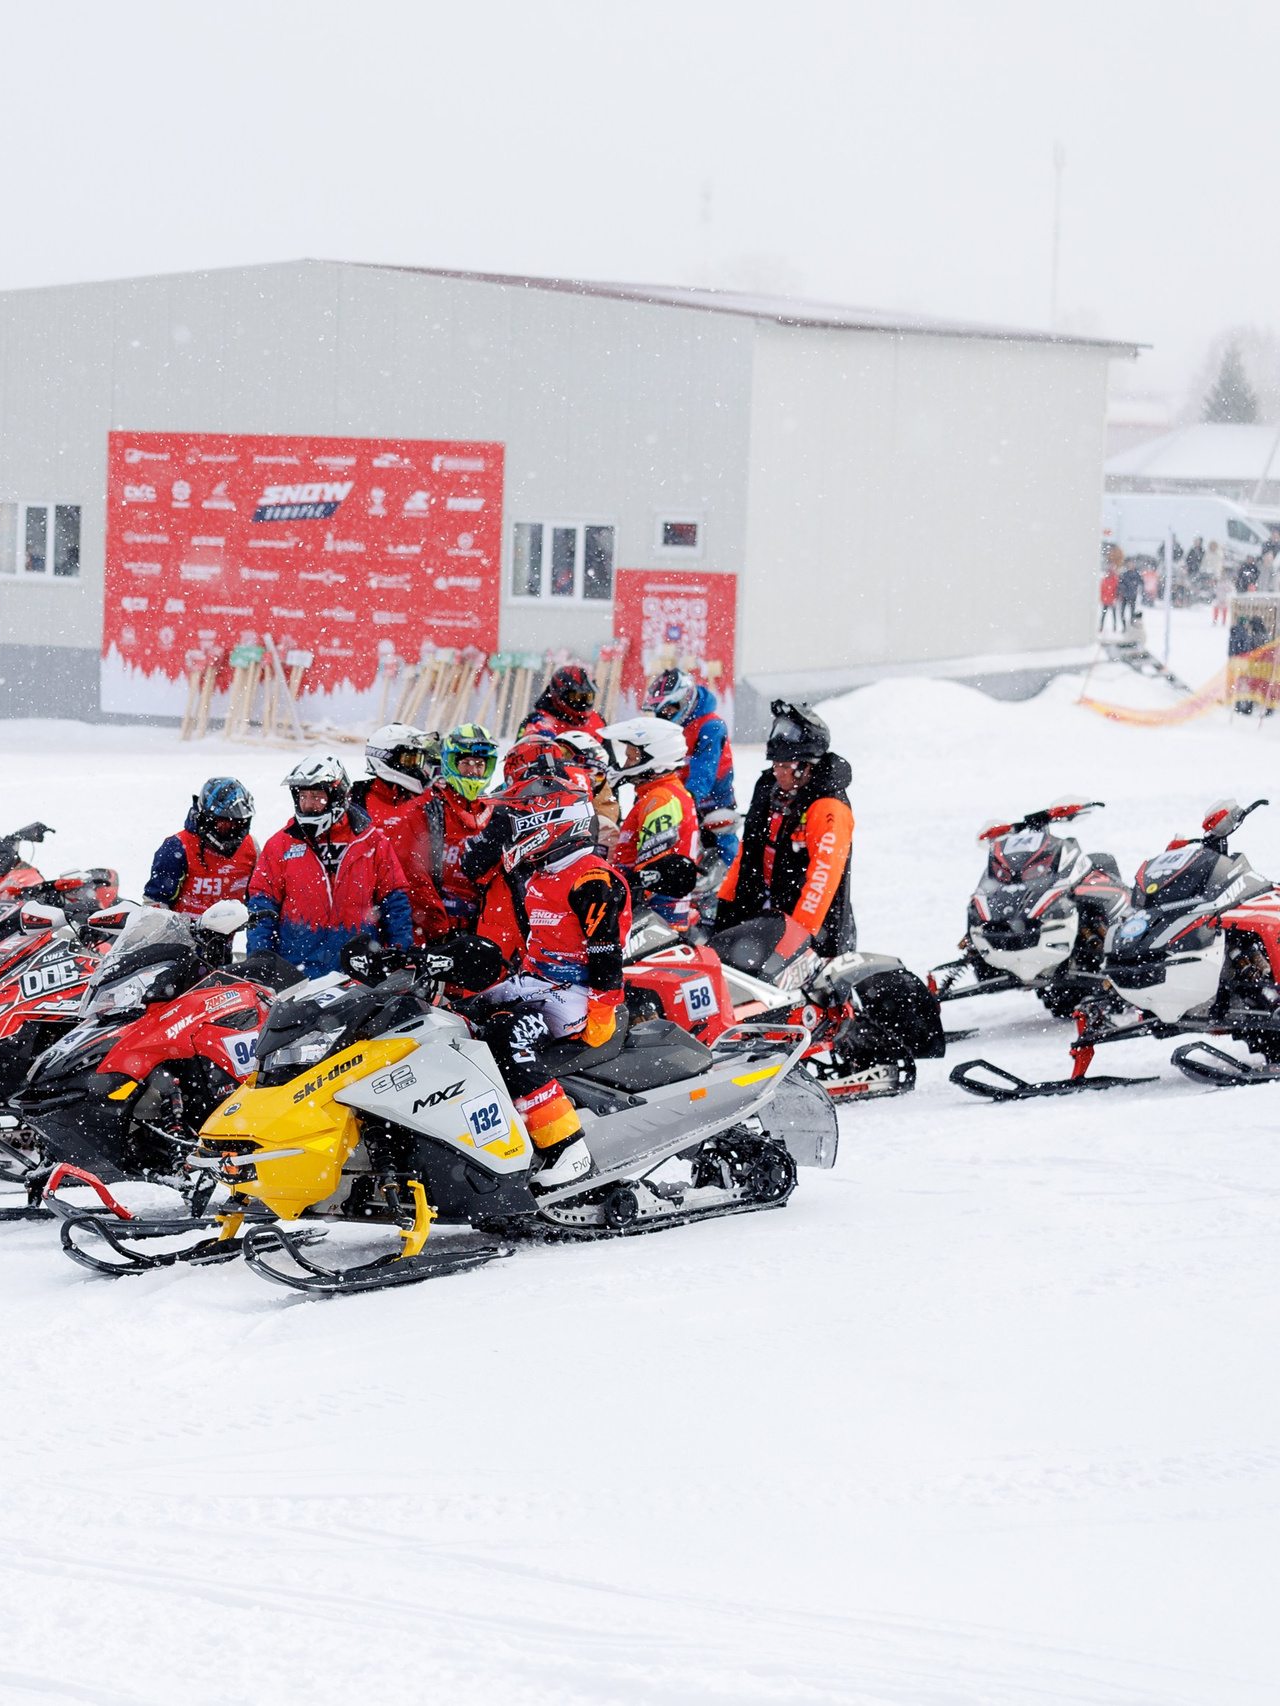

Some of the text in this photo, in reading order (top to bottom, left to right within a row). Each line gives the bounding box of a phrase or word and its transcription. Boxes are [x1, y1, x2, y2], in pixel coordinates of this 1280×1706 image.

[257, 481, 354, 505] SNOW
[517, 813, 547, 830] FXR
[192, 877, 222, 896] 353
[801, 860, 832, 915] READY
[42, 952, 65, 963] LYNX
[689, 986, 711, 1011] 58
[165, 1013, 194, 1040] LYNX
[234, 1038, 258, 1065] 94
[293, 1053, 363, 1104] ski-doo
[371, 1065, 415, 1095] 32
[412, 1079, 467, 1115] MXZ
[470, 1102, 502, 1136] 132
[504, 1147, 519, 1157] ROTAX
